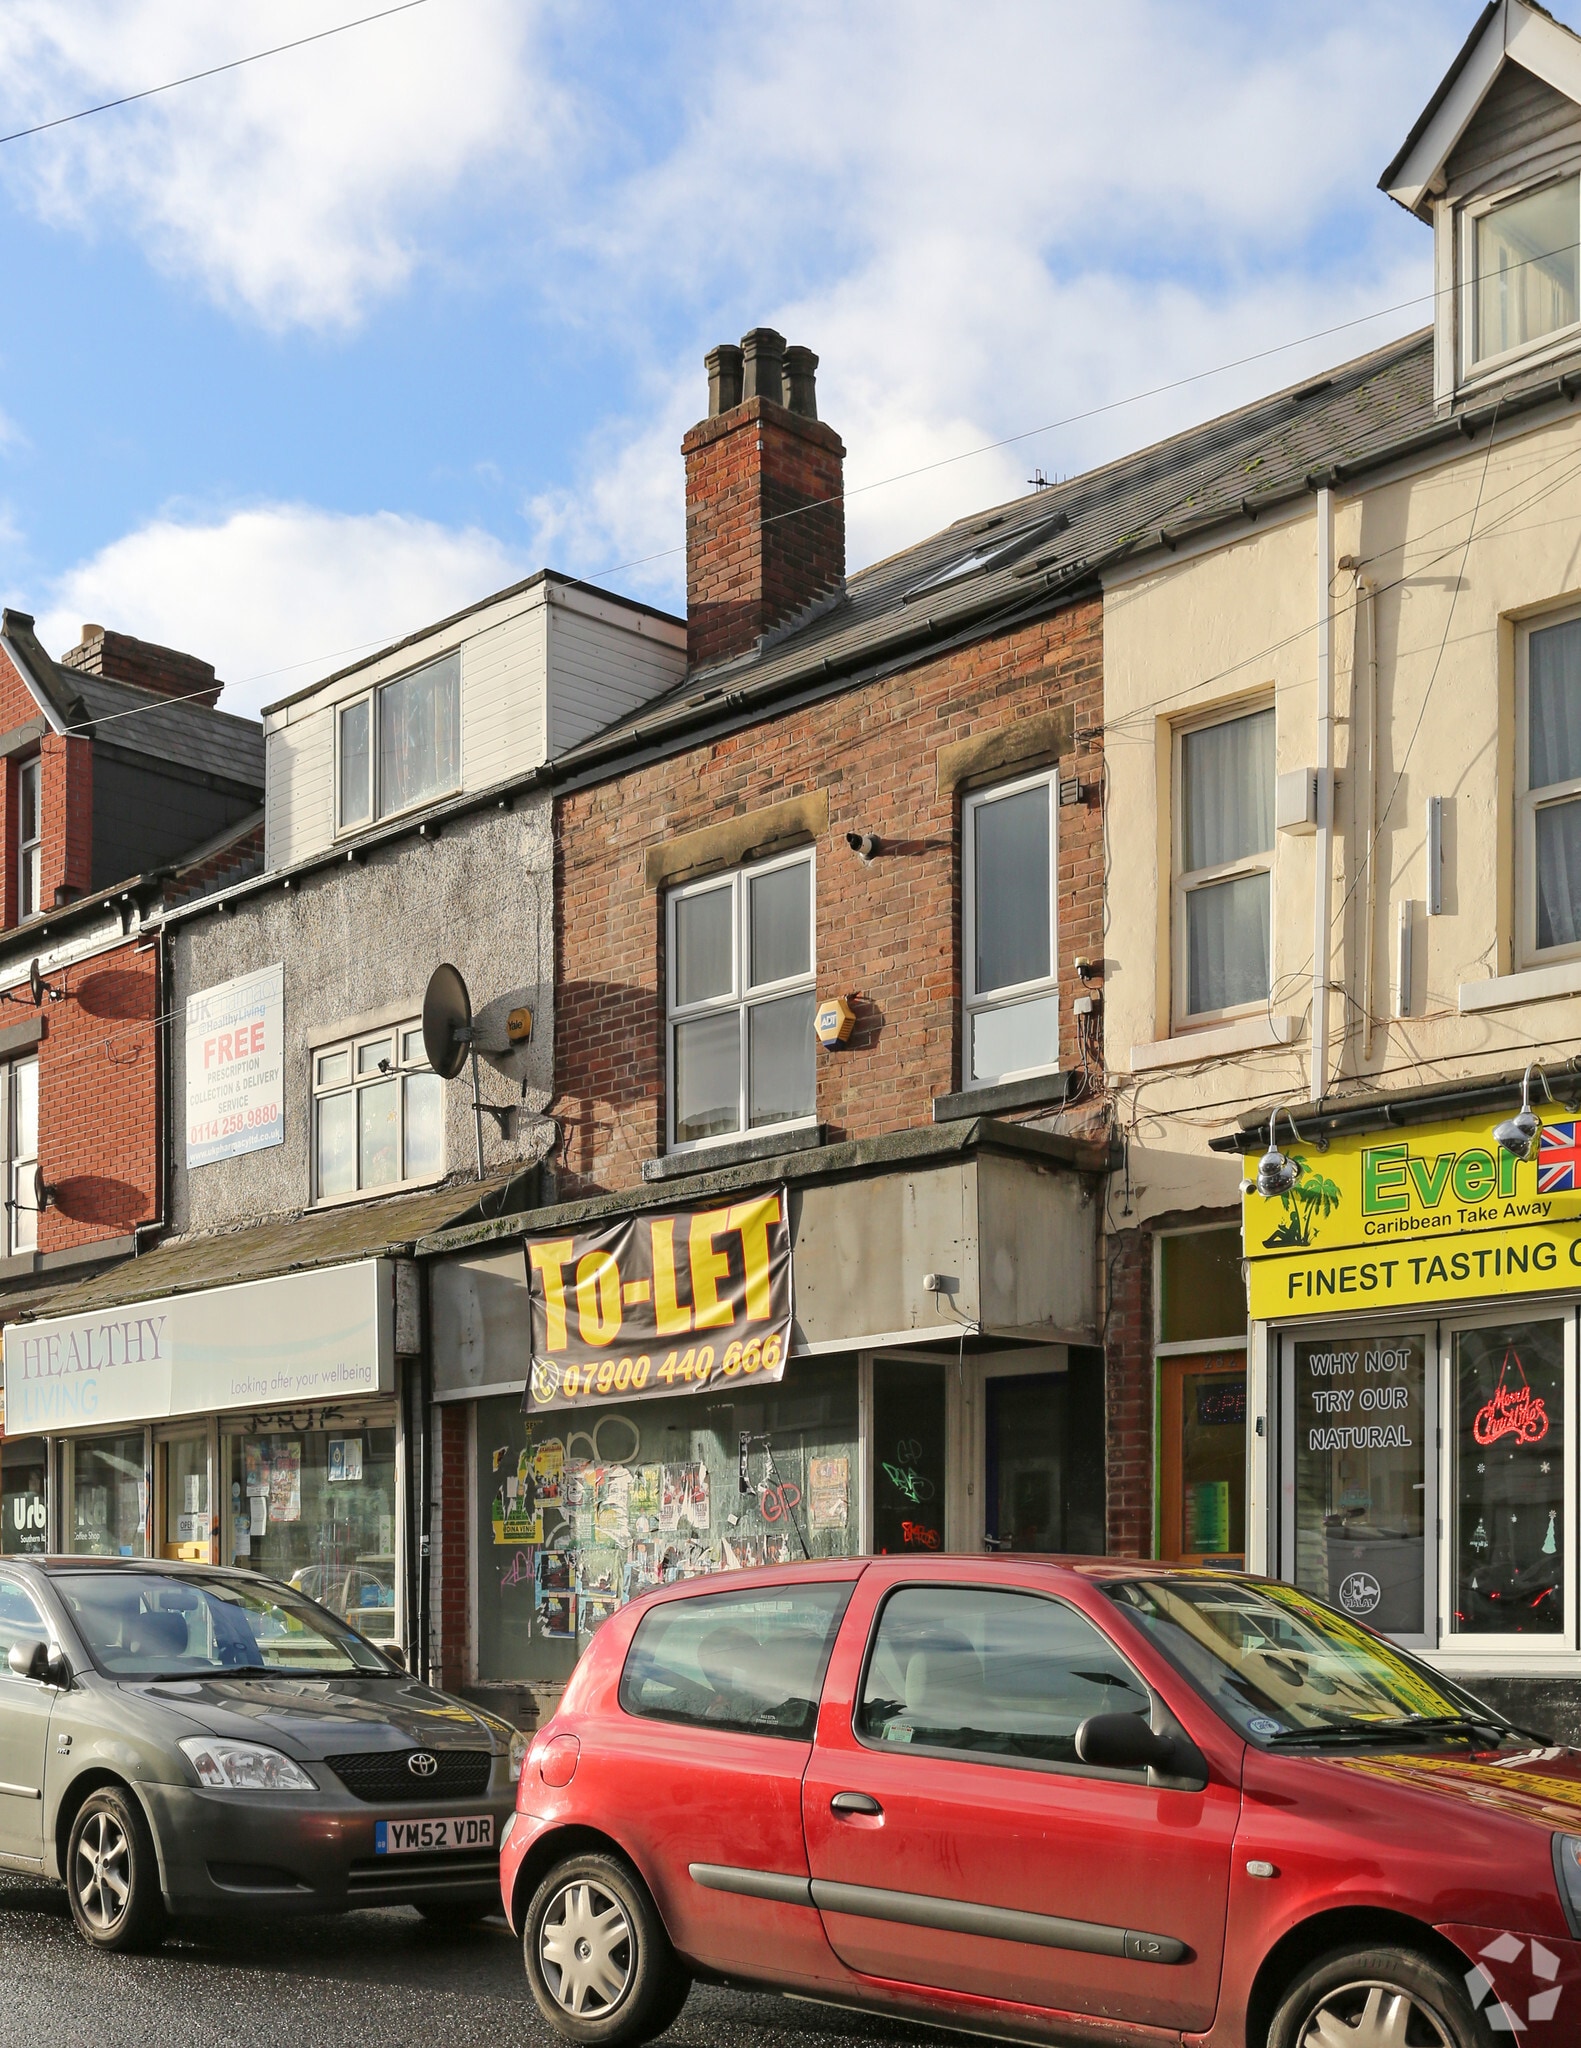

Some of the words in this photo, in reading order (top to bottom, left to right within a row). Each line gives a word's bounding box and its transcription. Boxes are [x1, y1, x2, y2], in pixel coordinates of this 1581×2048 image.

[507, 1020, 523, 1031] Yale
[821, 1013, 837, 1027] ADT
[204, 1021, 265, 1069] FREE
[208, 1056, 260, 1084] PRESCRIPTION
[190, 1083, 233, 1106] COLLECTION
[236, 1081, 240, 1092] &
[243, 1068, 279, 1090] DELIVERY
[218, 1095, 248, 1114] SERVICE
[191, 1121, 219, 1144] 0114
[222, 1113, 243, 1135] 258
[247, 1103, 277, 1128] 9880
[1361, 1142, 1528, 1217] Ever
[1364, 1207, 1452, 1236] Caribbean
[1457, 1207, 1498, 1224] Take
[1503, 1201, 1552, 1218] Away
[529, 1196, 782, 1353] TO-LET
[1288, 1260, 1400, 1299] FINEST
[1407, 1242, 1558, 1285] TASTING
[21, 1315, 167, 1380] HEALTHY
[1310, 1352, 1358, 1376] WHY
[1365, 1349, 1411, 1373] NOT
[231, 1376, 267, 1395] Looking
[271, 1371, 293, 1390] after
[296, 1373, 318, 1391] your
[321, 1363, 371, 1383] wellbeing
[562, 1354, 651, 1397] 07900
[657, 1345, 715, 1384] 440
[723, 1334, 782, 1377] 666
[23, 1378, 98, 1422] LIVING
[1206, 1394, 1246, 1414] OPE
[1312, 1389, 1354, 1413] TRY
[1360, 1387, 1408, 1410] OUR
[1494, 1384, 1530, 1410] Merry
[1310, 1425, 1412, 1451] NATURAL
[13, 1496, 46, 1531] Urb
[761, 1483, 801, 1522] GP
[88, 1532, 100, 1541] Shop
[1345, 1599, 1375, 1608] HALAL
[392, 1822, 447, 1848] YM52
[454, 1819, 491, 1844] VDR
[1134, 1940, 1161, 1955] 1.2
